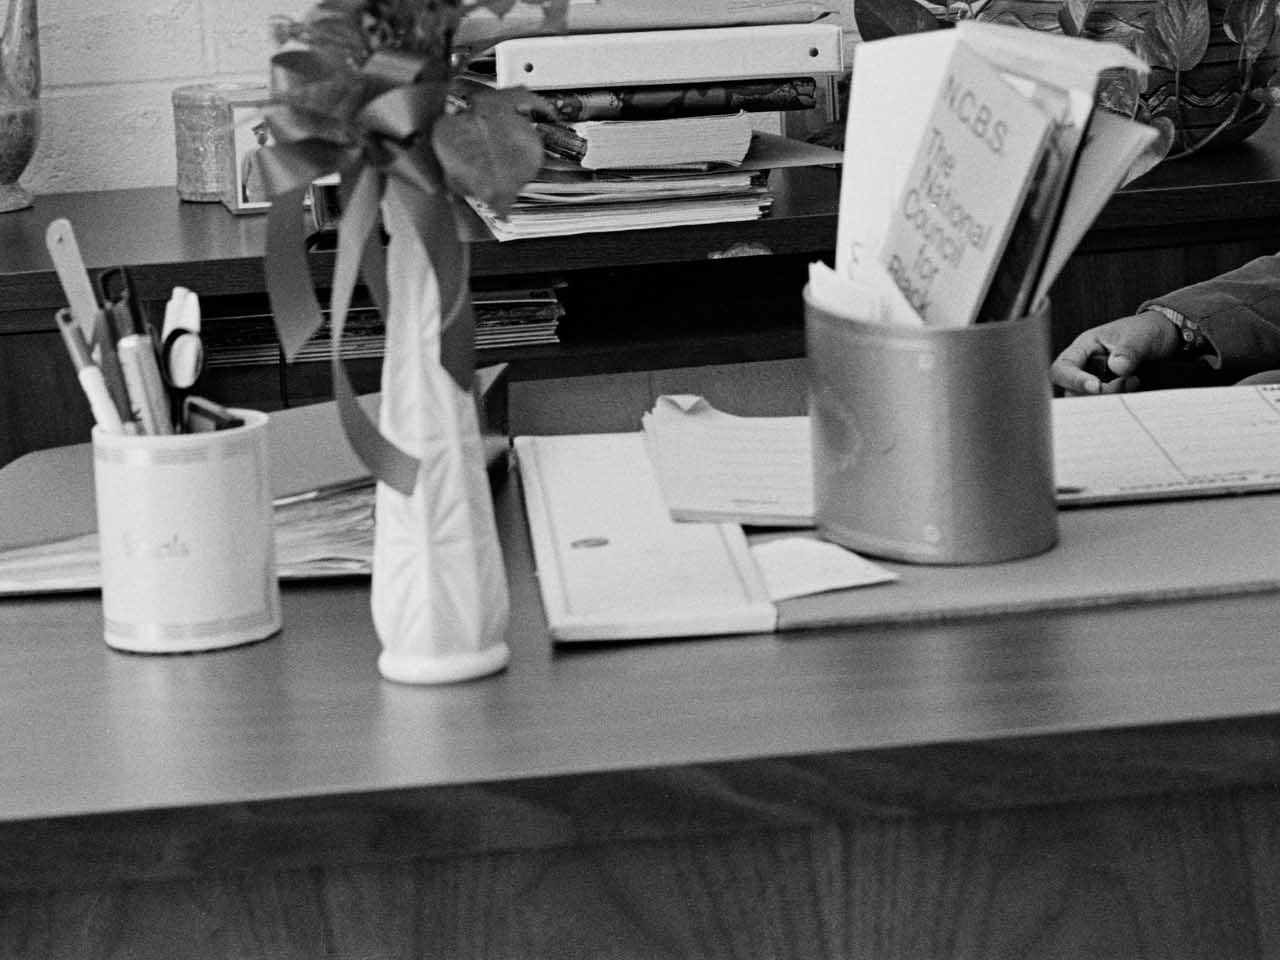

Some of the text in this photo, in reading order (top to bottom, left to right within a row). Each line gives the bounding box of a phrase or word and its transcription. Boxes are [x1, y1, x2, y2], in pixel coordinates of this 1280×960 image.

[926, 126, 955, 178] The
[944, 74, 1009, 156] NCBS
[902, 187, 968, 270] Council
[920, 162, 994, 252] National
[913, 242, 940, 286] for
